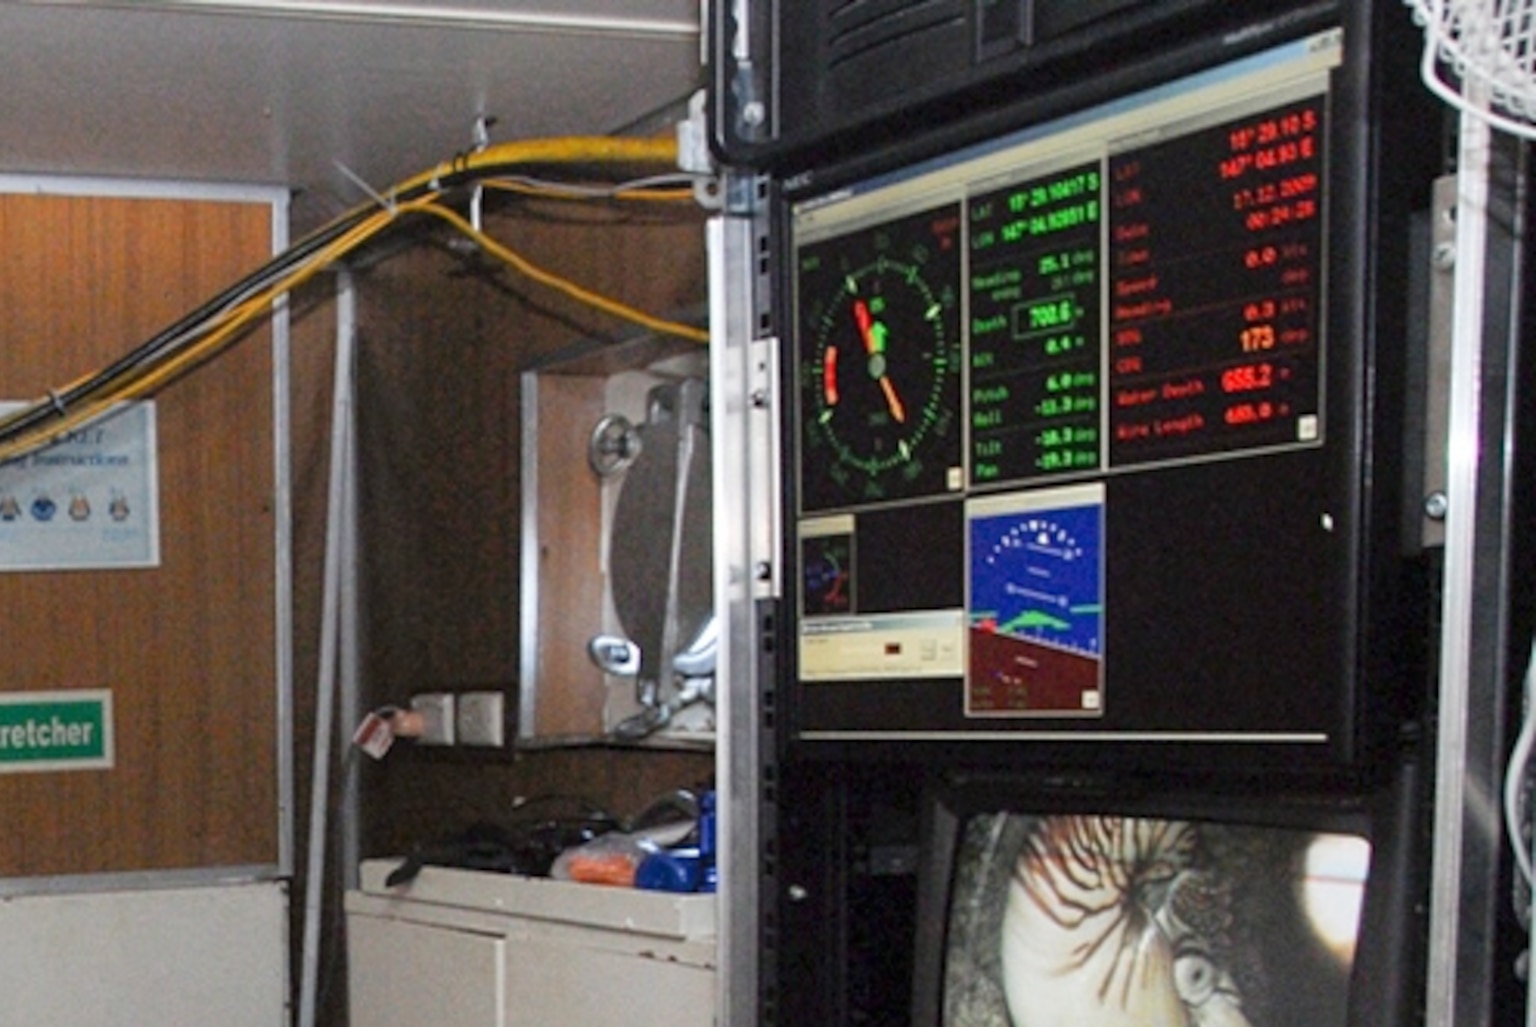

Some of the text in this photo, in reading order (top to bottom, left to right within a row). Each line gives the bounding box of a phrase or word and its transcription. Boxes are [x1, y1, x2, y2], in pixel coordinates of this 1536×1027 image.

[1302, 110, 1317, 131] S
[1300, 137, 1314, 157] E
[1240, 326, 1275, 352] 173
